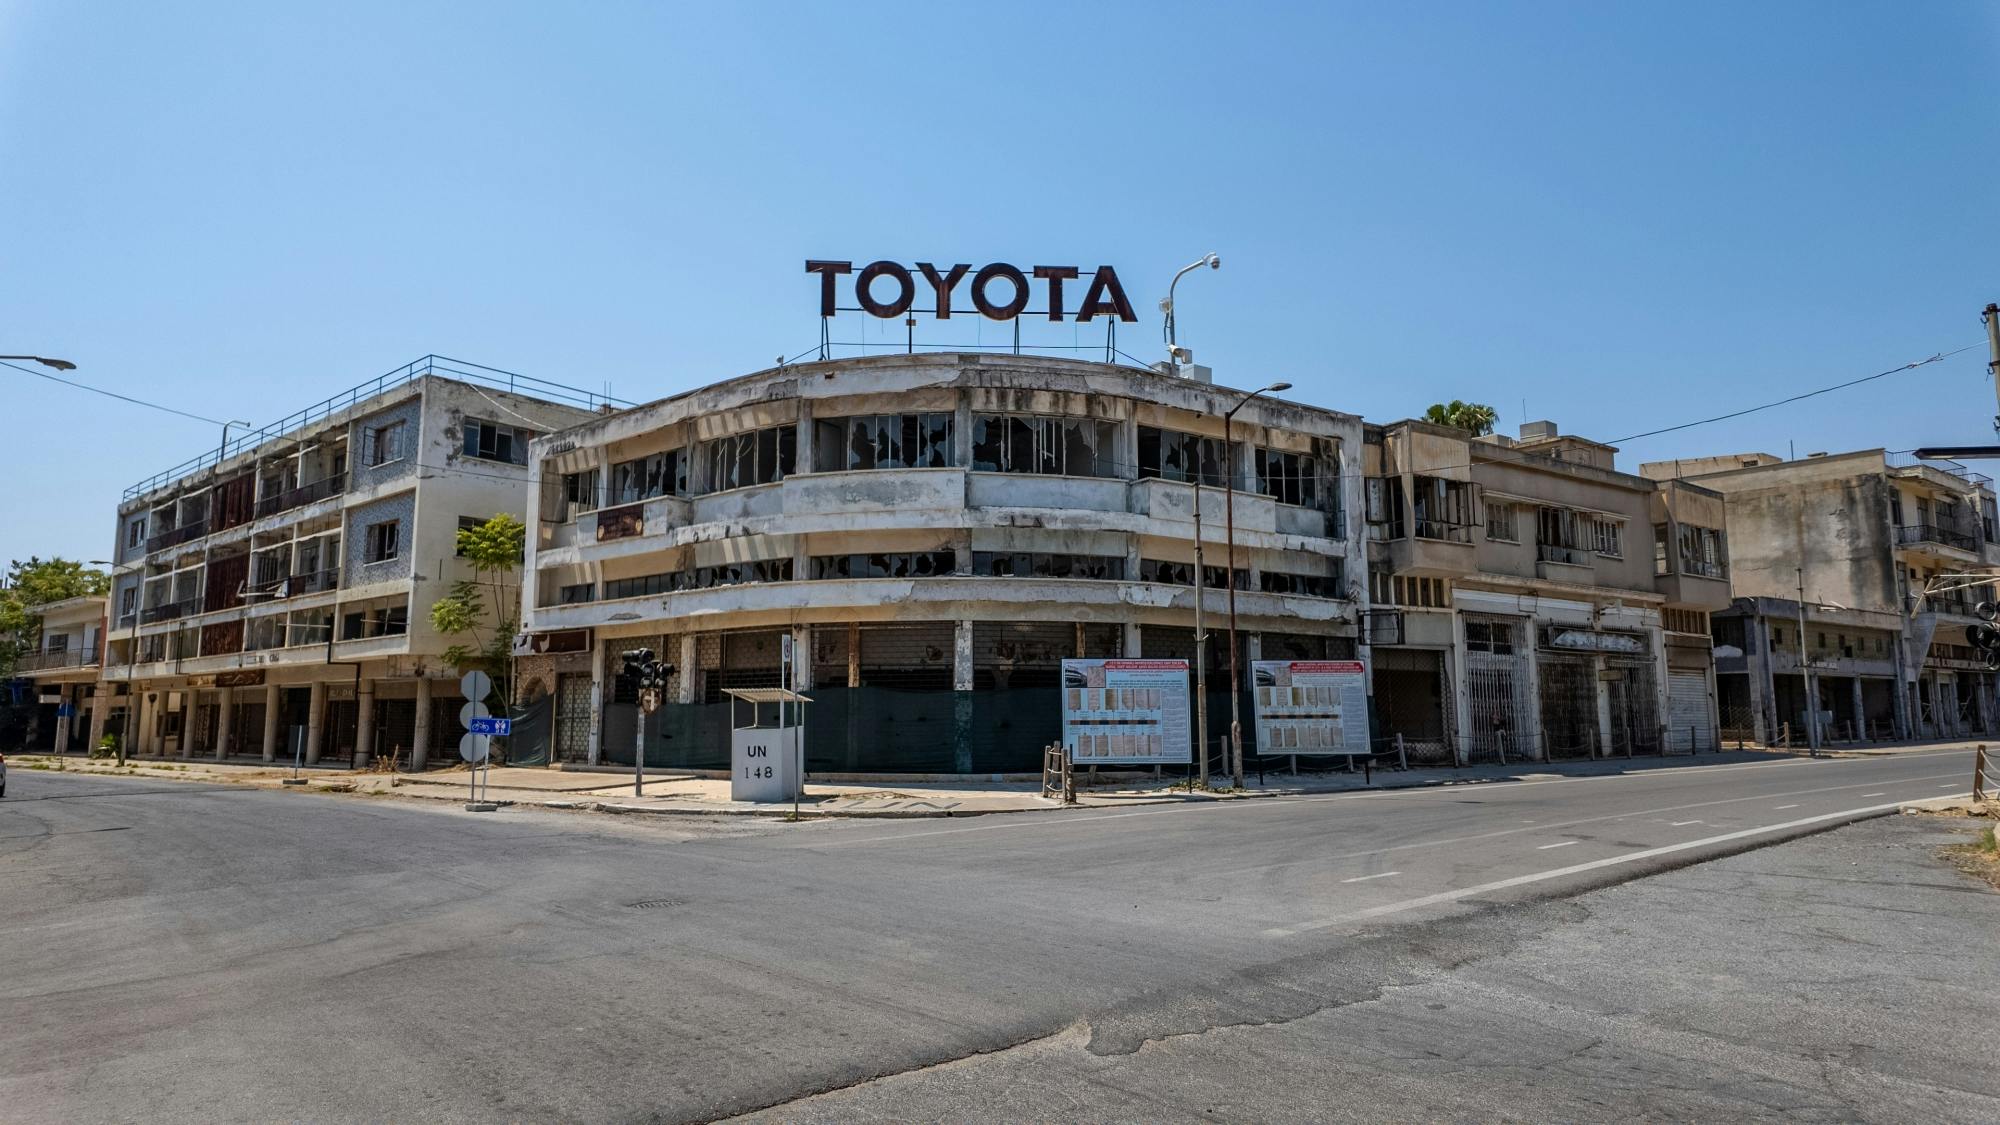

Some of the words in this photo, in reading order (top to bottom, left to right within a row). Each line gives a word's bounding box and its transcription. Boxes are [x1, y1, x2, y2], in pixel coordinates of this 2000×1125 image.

[805, 260, 1138, 322] TOYOTA
[747, 745, 767, 758] UN
[745, 766, 773, 779] 148
